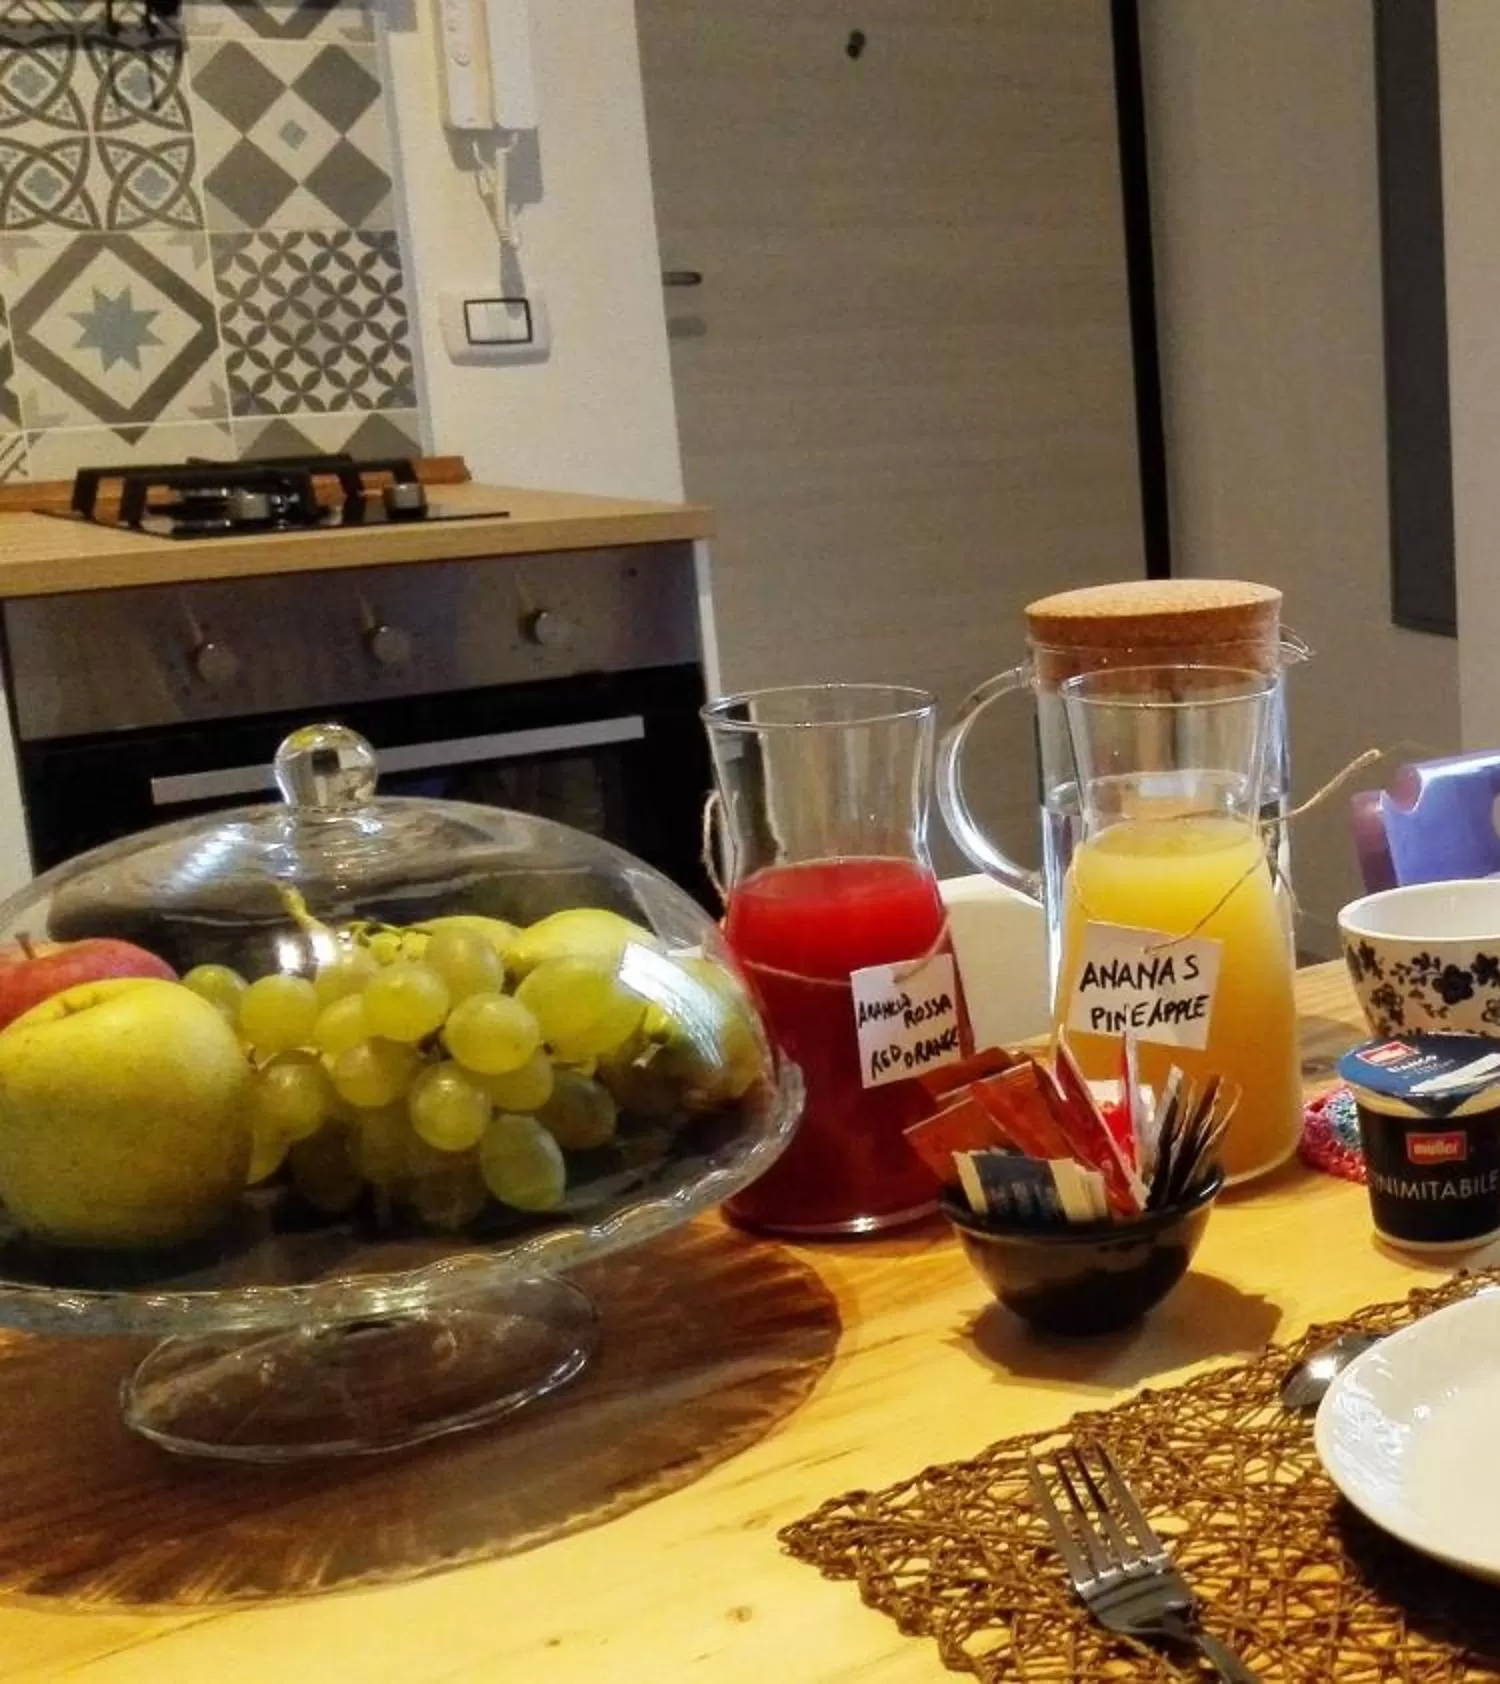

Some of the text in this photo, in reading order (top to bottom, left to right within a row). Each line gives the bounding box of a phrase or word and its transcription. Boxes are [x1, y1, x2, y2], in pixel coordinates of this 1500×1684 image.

[1079, 954, 1200, 992] ANANAS
[903, 993, 953, 1029] ROSSA
[1091, 994, 1210, 1033] PINEAPPLE
[871, 1043, 902, 1080] RED
